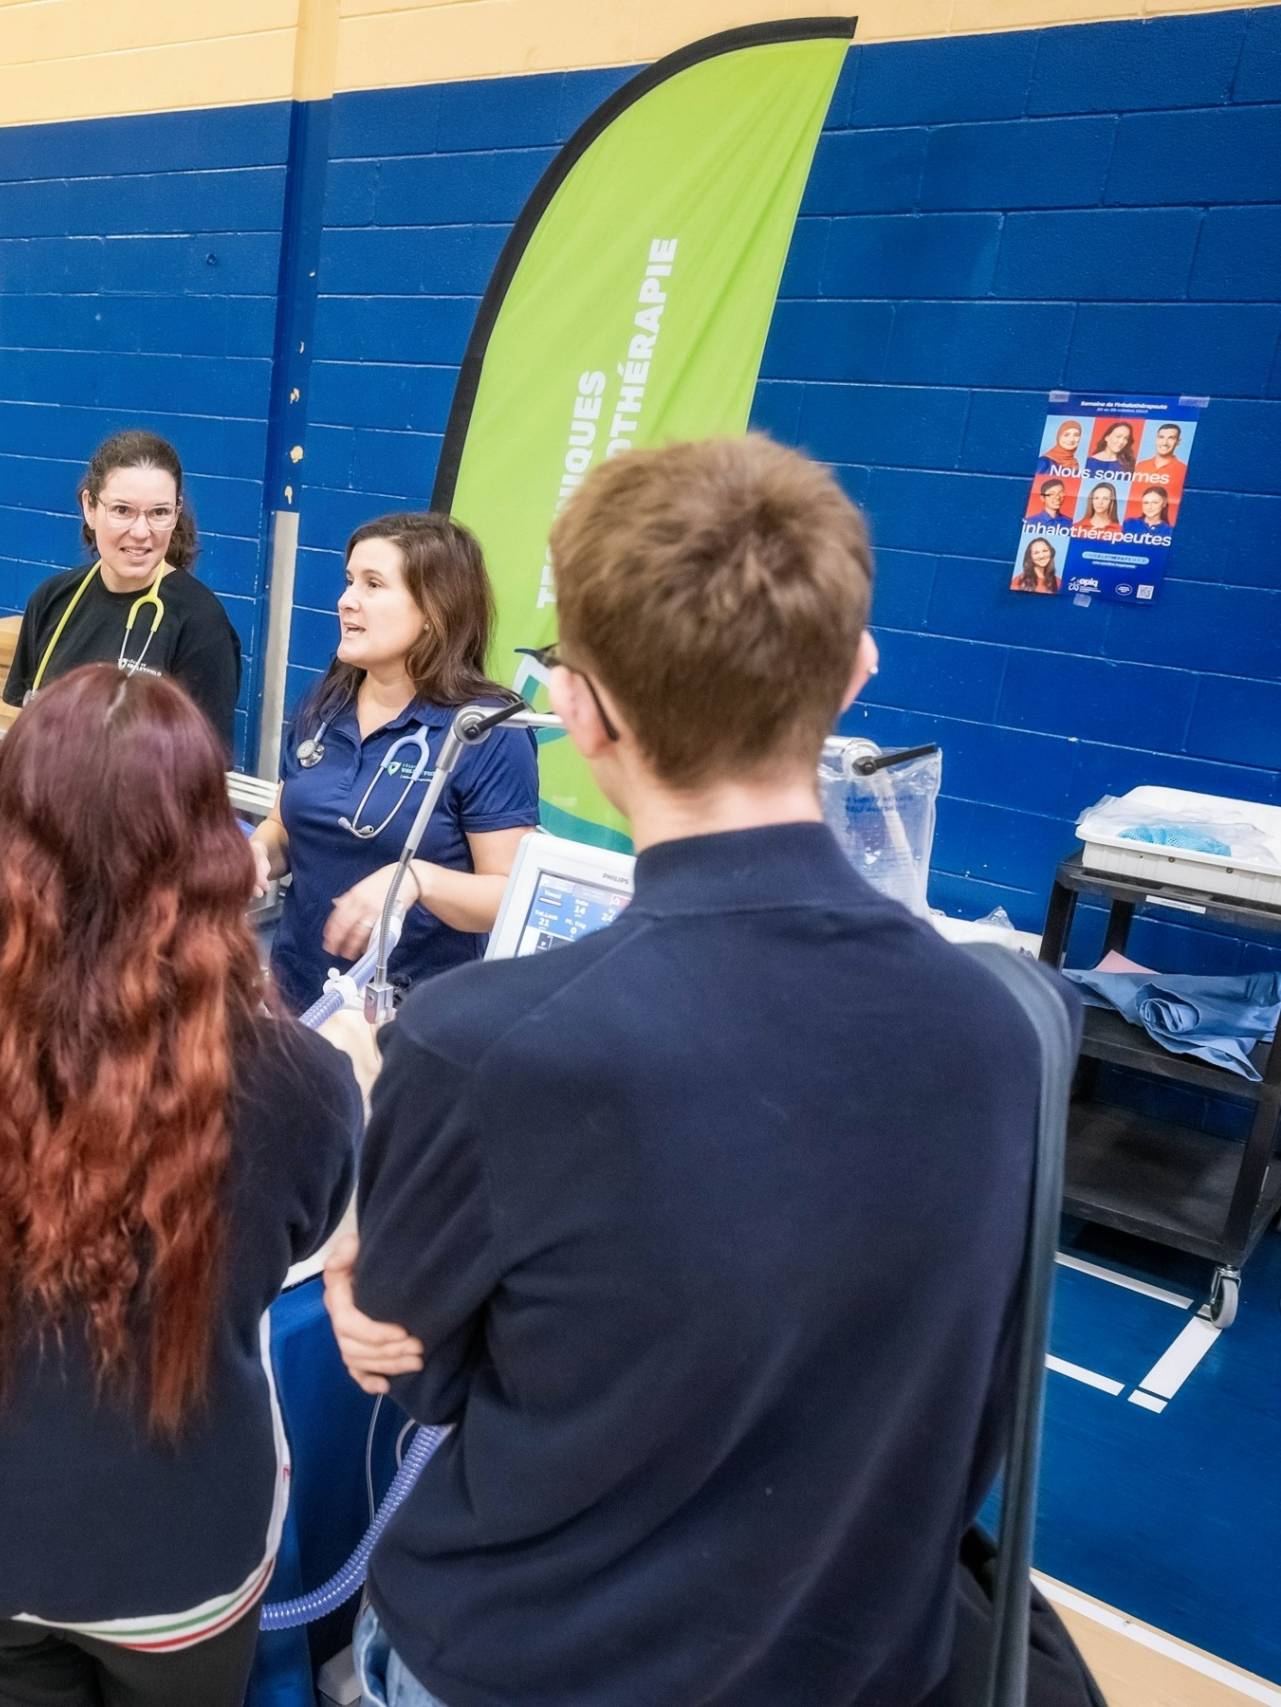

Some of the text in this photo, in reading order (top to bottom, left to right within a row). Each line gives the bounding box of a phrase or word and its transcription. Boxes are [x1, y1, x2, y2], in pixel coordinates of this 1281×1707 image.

[606, 239, 678, 460] OTHÉRAPIE
[1049, 465, 1170, 484] Nous sommes
